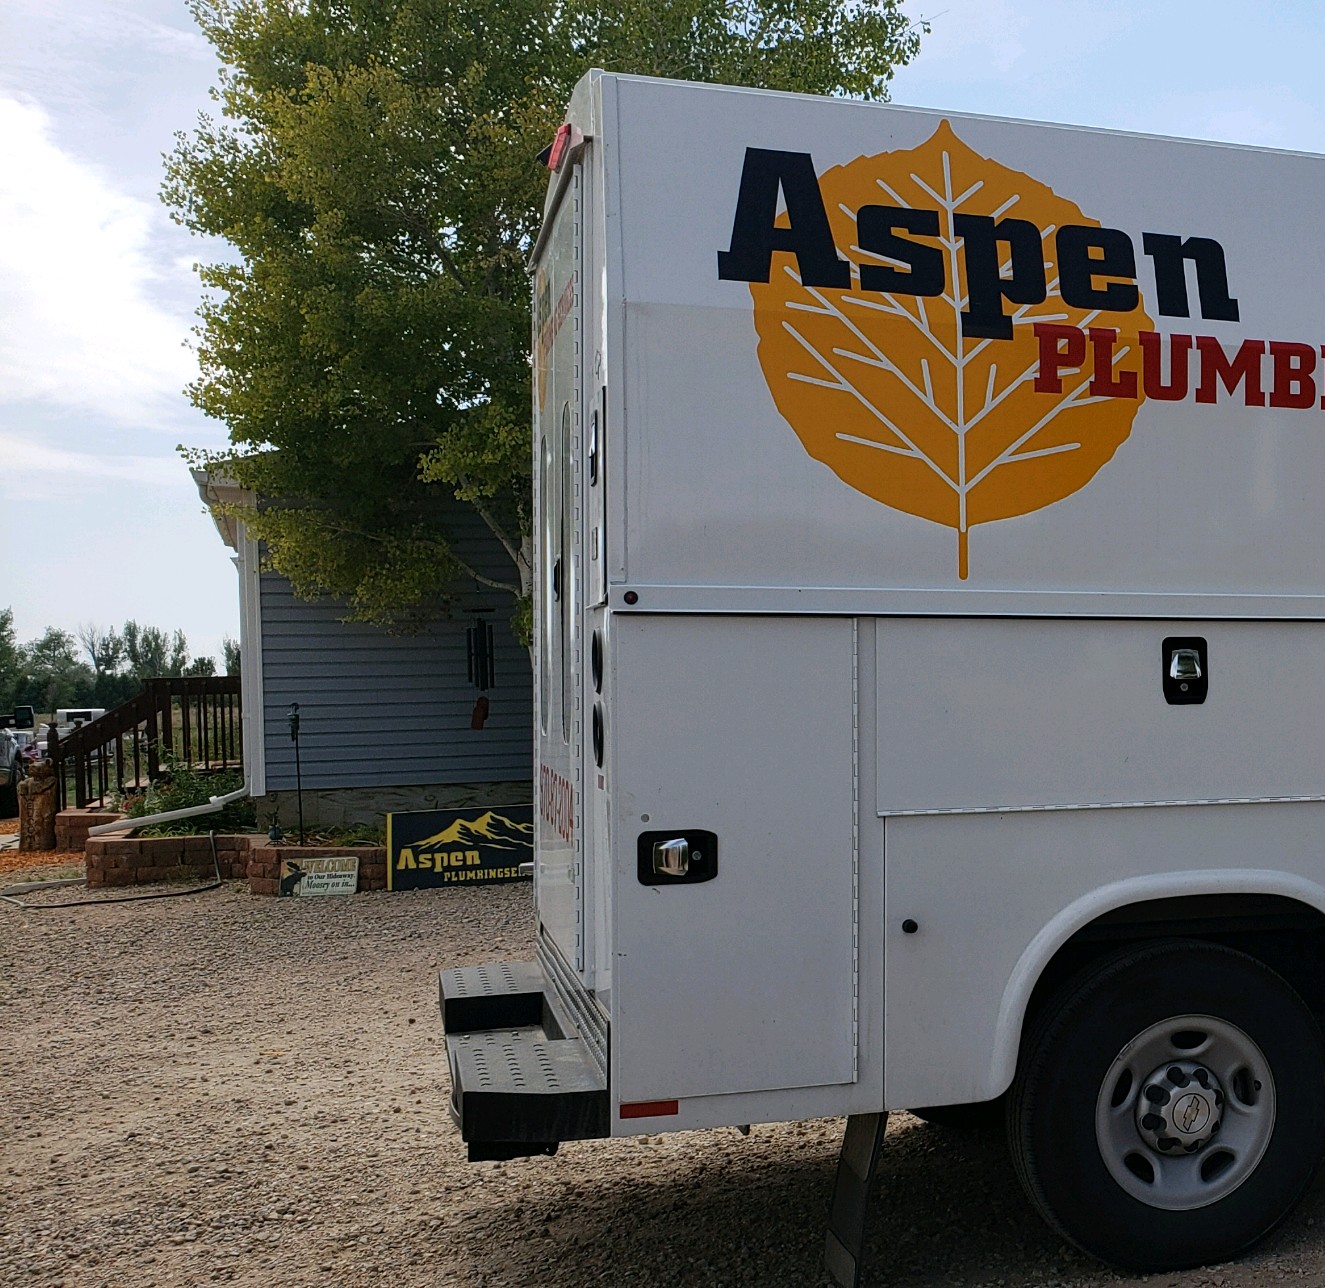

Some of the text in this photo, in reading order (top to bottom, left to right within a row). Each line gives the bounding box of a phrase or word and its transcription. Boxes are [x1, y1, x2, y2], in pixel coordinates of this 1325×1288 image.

[717, 147, 1240, 340] Aspen
[304, 859, 356, 873] WELCOME
[396, 848, 481, 873] Aspen
